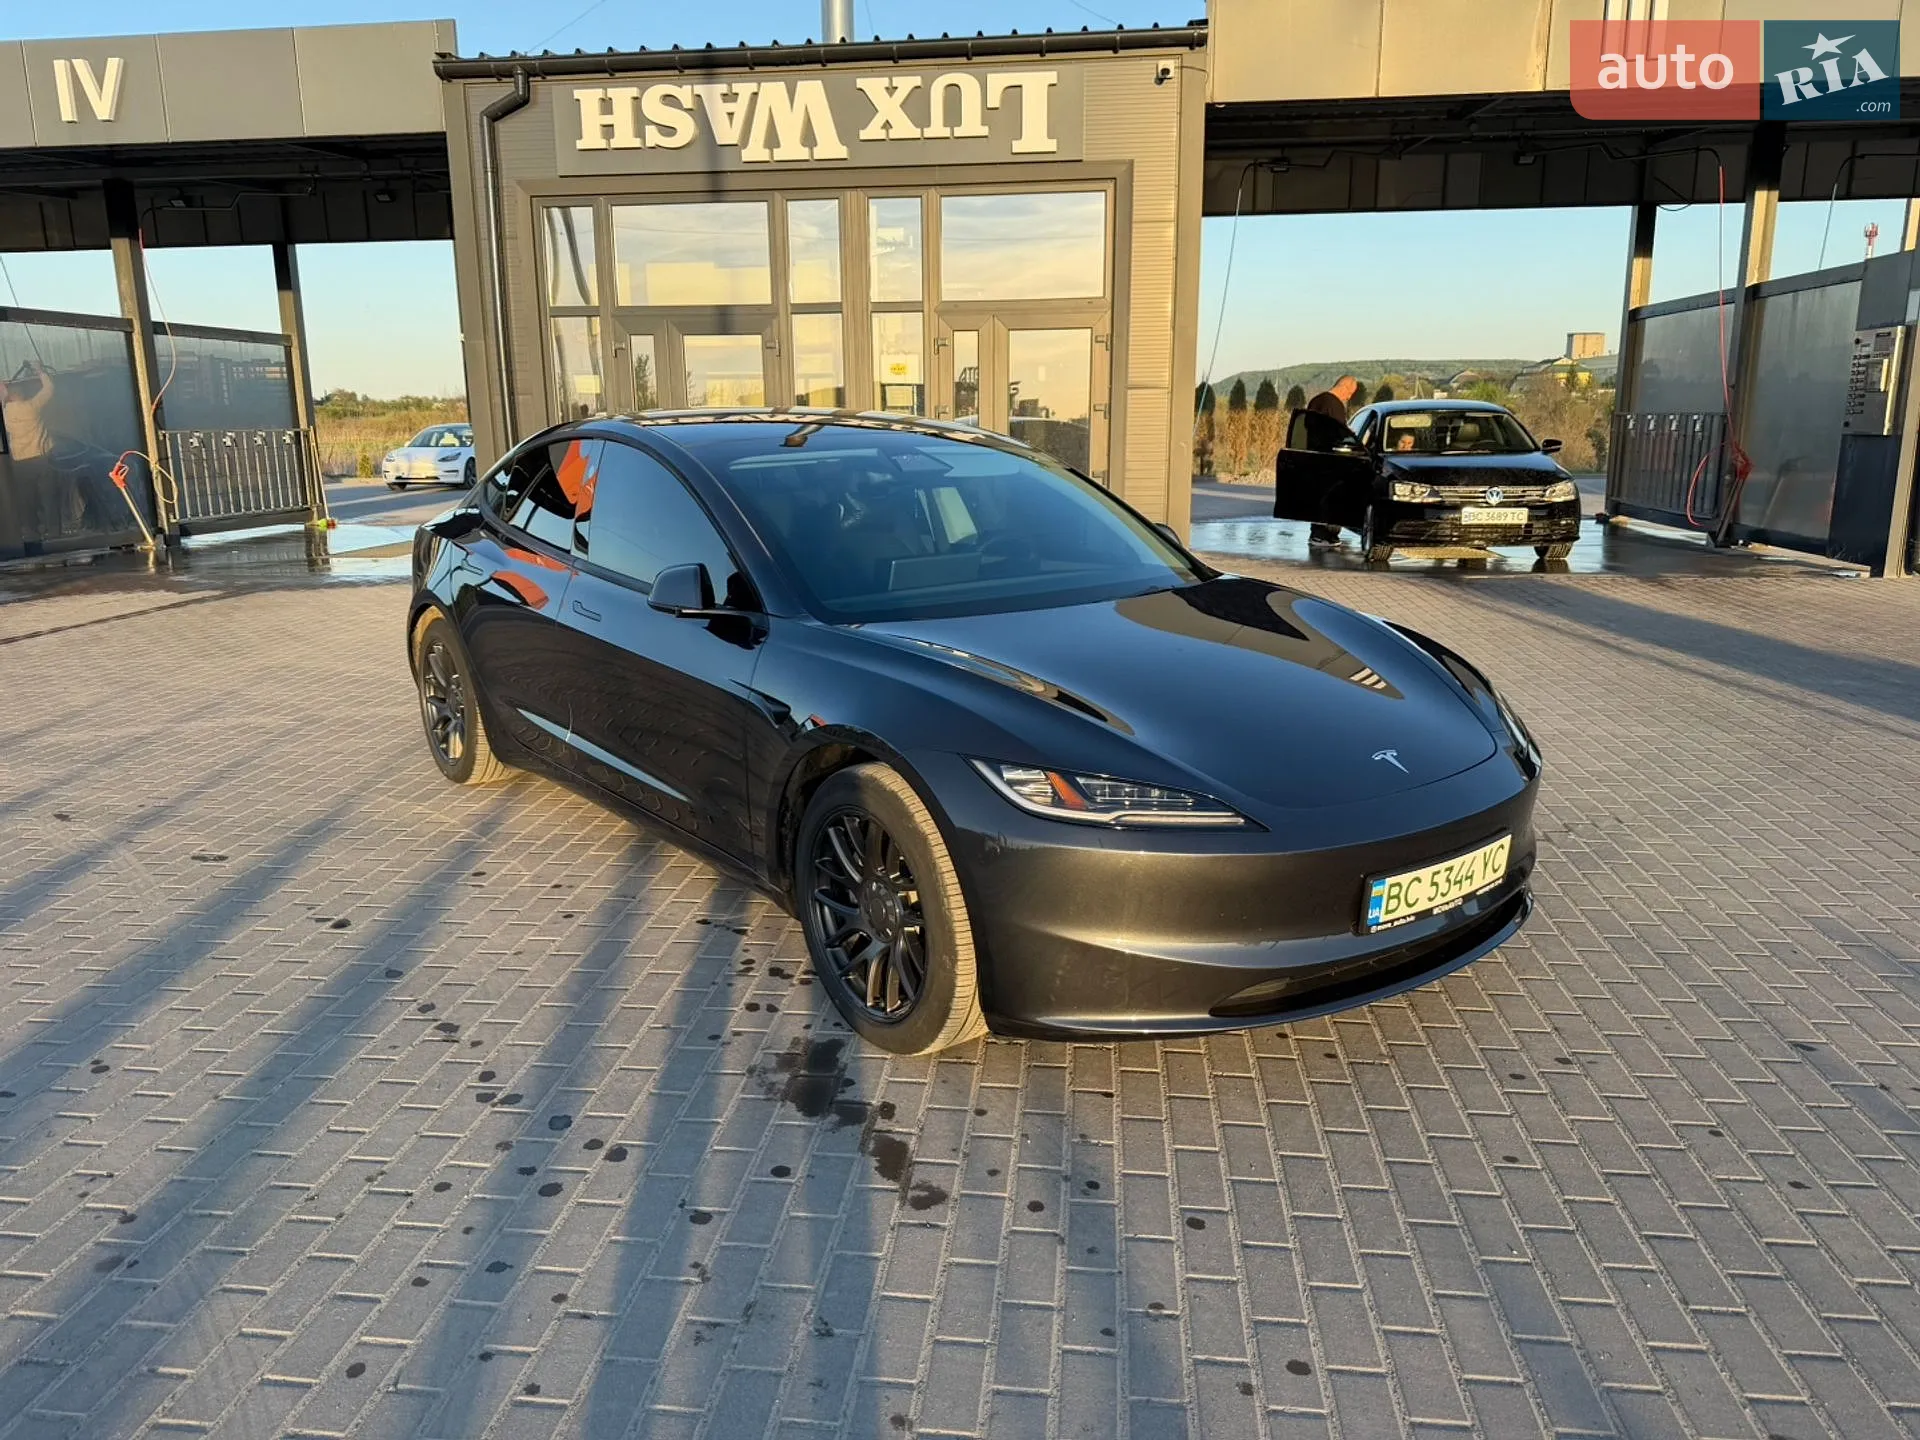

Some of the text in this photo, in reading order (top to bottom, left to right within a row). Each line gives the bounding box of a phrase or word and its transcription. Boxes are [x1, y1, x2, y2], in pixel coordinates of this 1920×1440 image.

[53, 58, 123, 122] IV
[573, 71, 1058, 163] LUX WASH
[1510, 511, 1524, 521] TC
[1384, 876, 1422, 915] BC
[1427, 855, 1477, 902] 5344
[1482, 843, 1505, 880] YC
